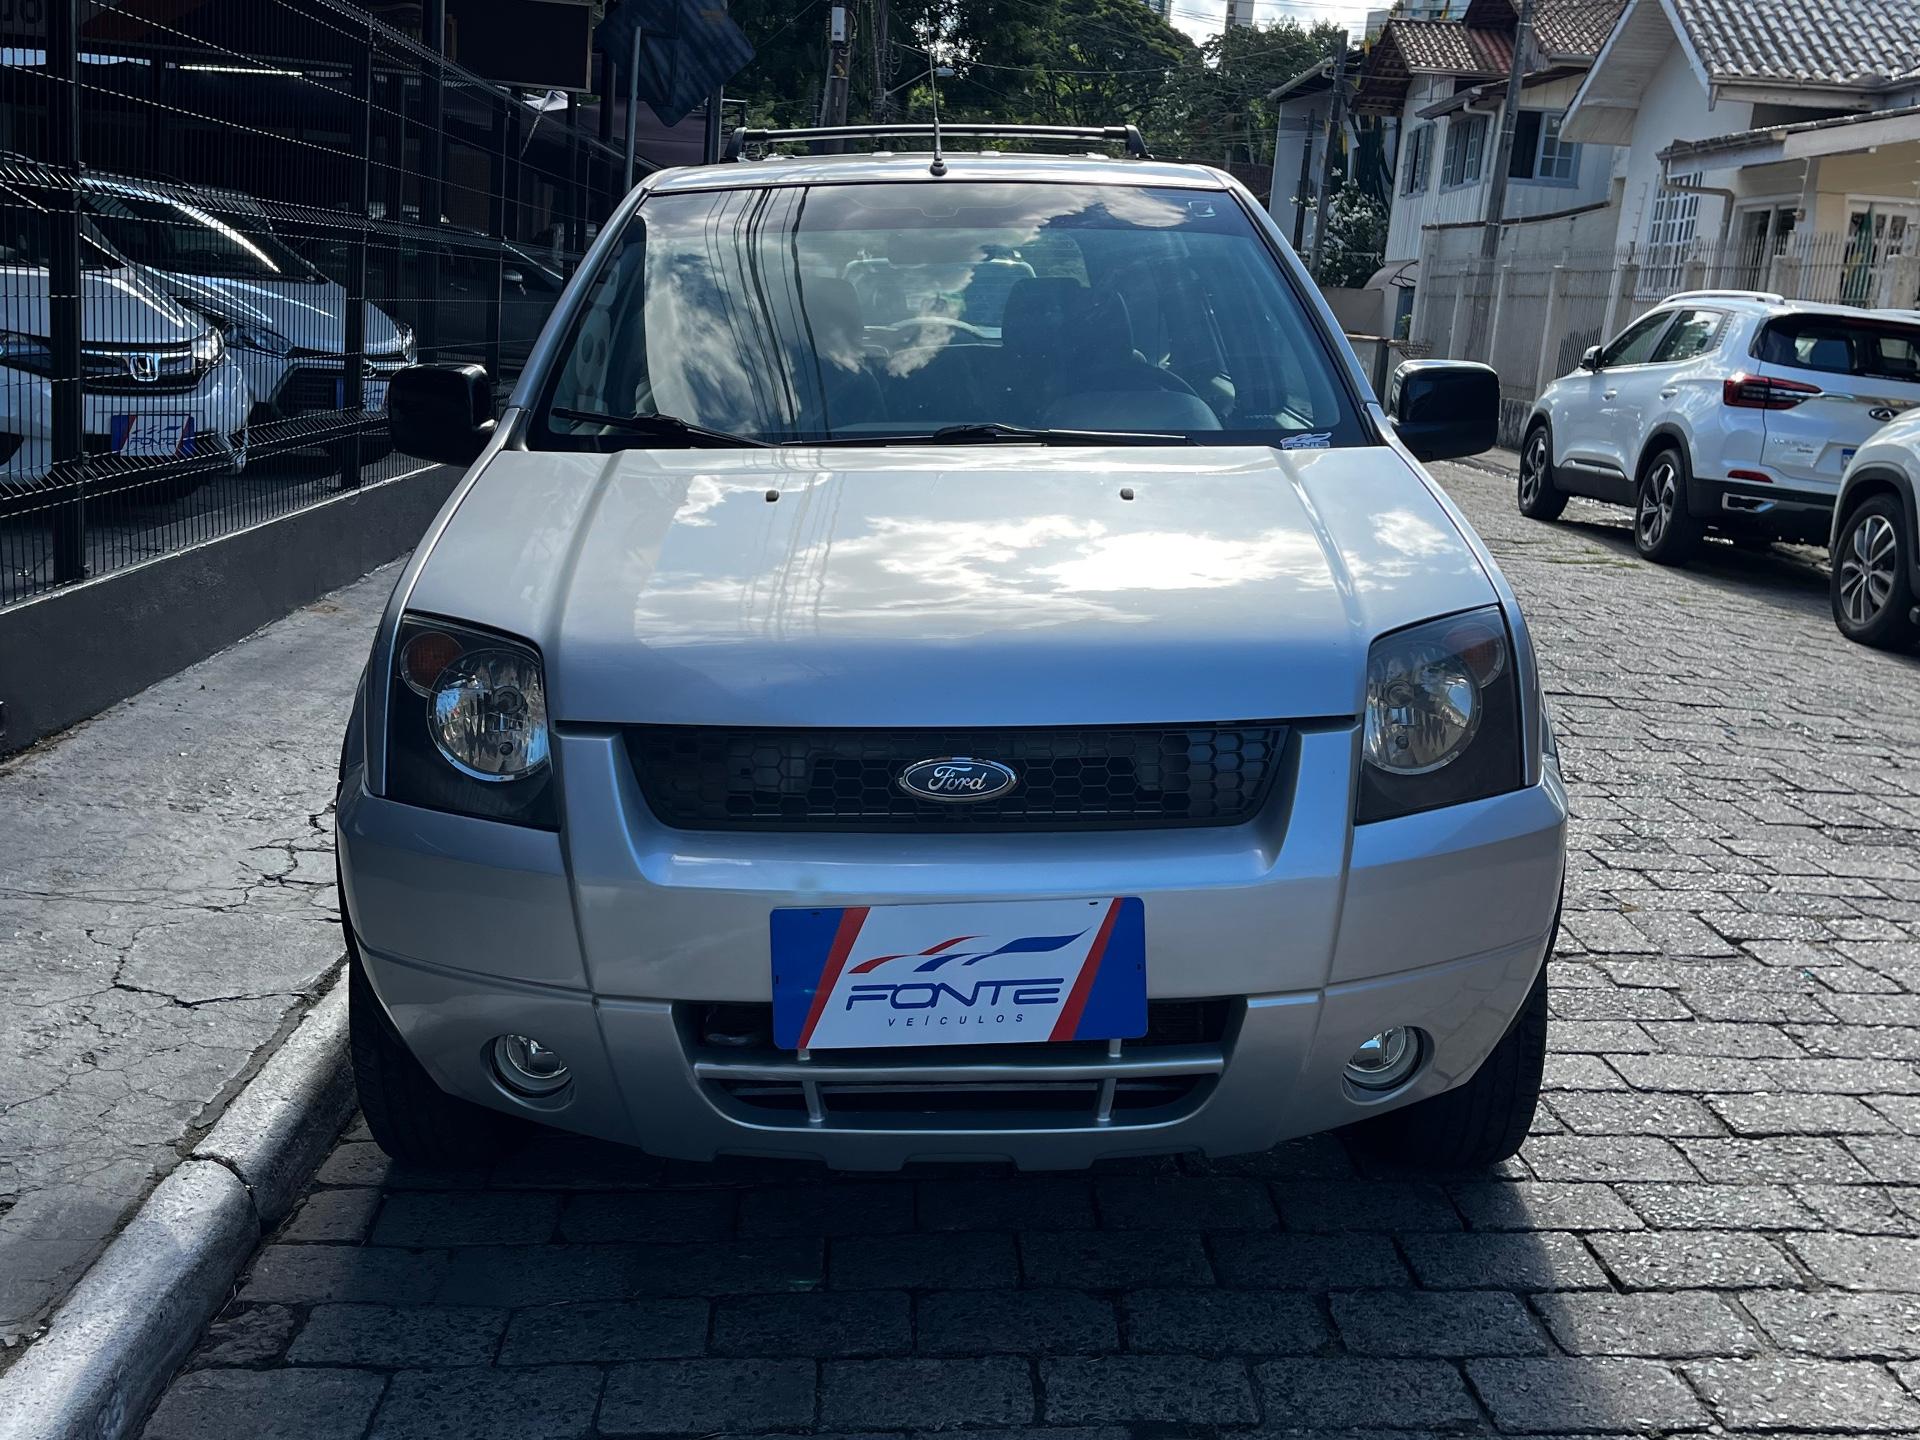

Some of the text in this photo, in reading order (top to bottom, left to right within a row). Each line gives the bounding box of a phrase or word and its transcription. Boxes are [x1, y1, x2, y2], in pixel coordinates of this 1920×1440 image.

[928, 765, 988, 791] Ford
[845, 977, 1065, 1011] FONTE
[888, 1013, 1024, 1027] VEÍCULOS
